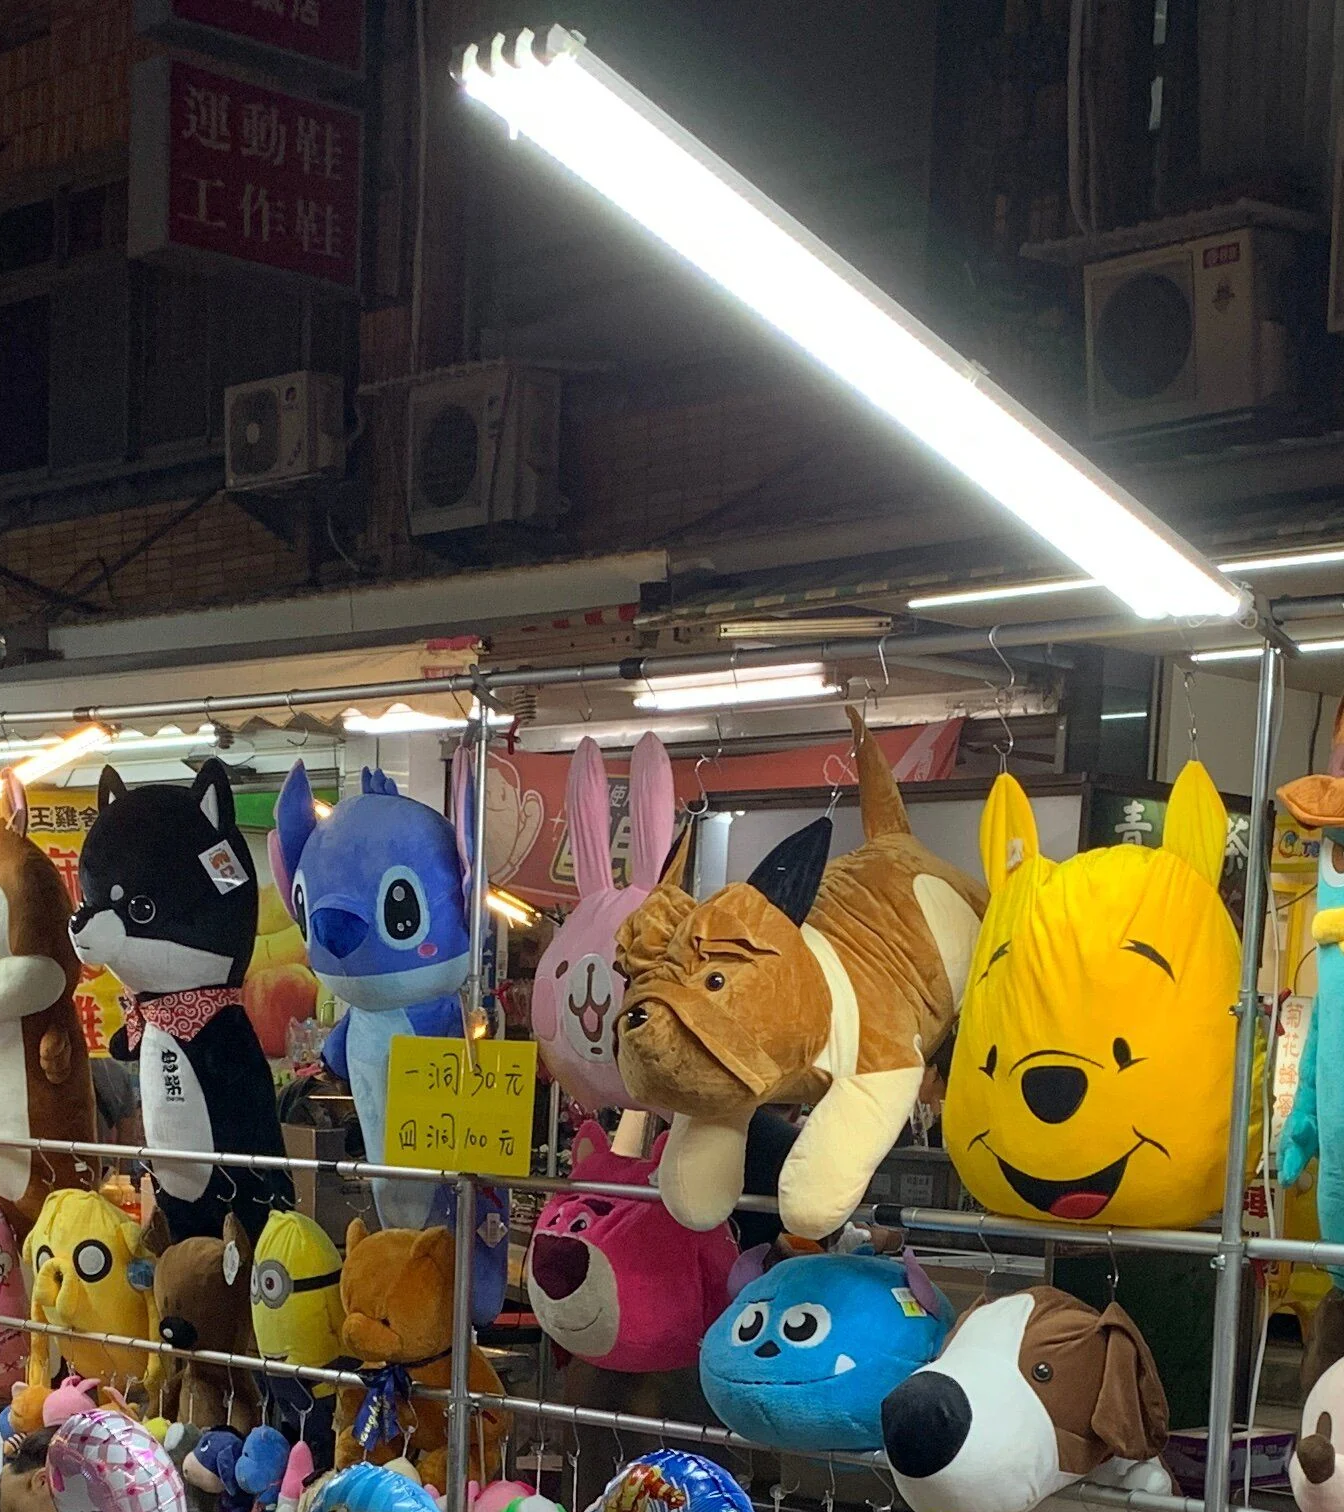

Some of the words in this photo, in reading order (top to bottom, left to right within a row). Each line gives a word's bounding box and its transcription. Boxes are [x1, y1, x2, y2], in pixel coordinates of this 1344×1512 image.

[182, 81, 344, 181] 運動鞋
[177, 172, 344, 260] 工作鞋
